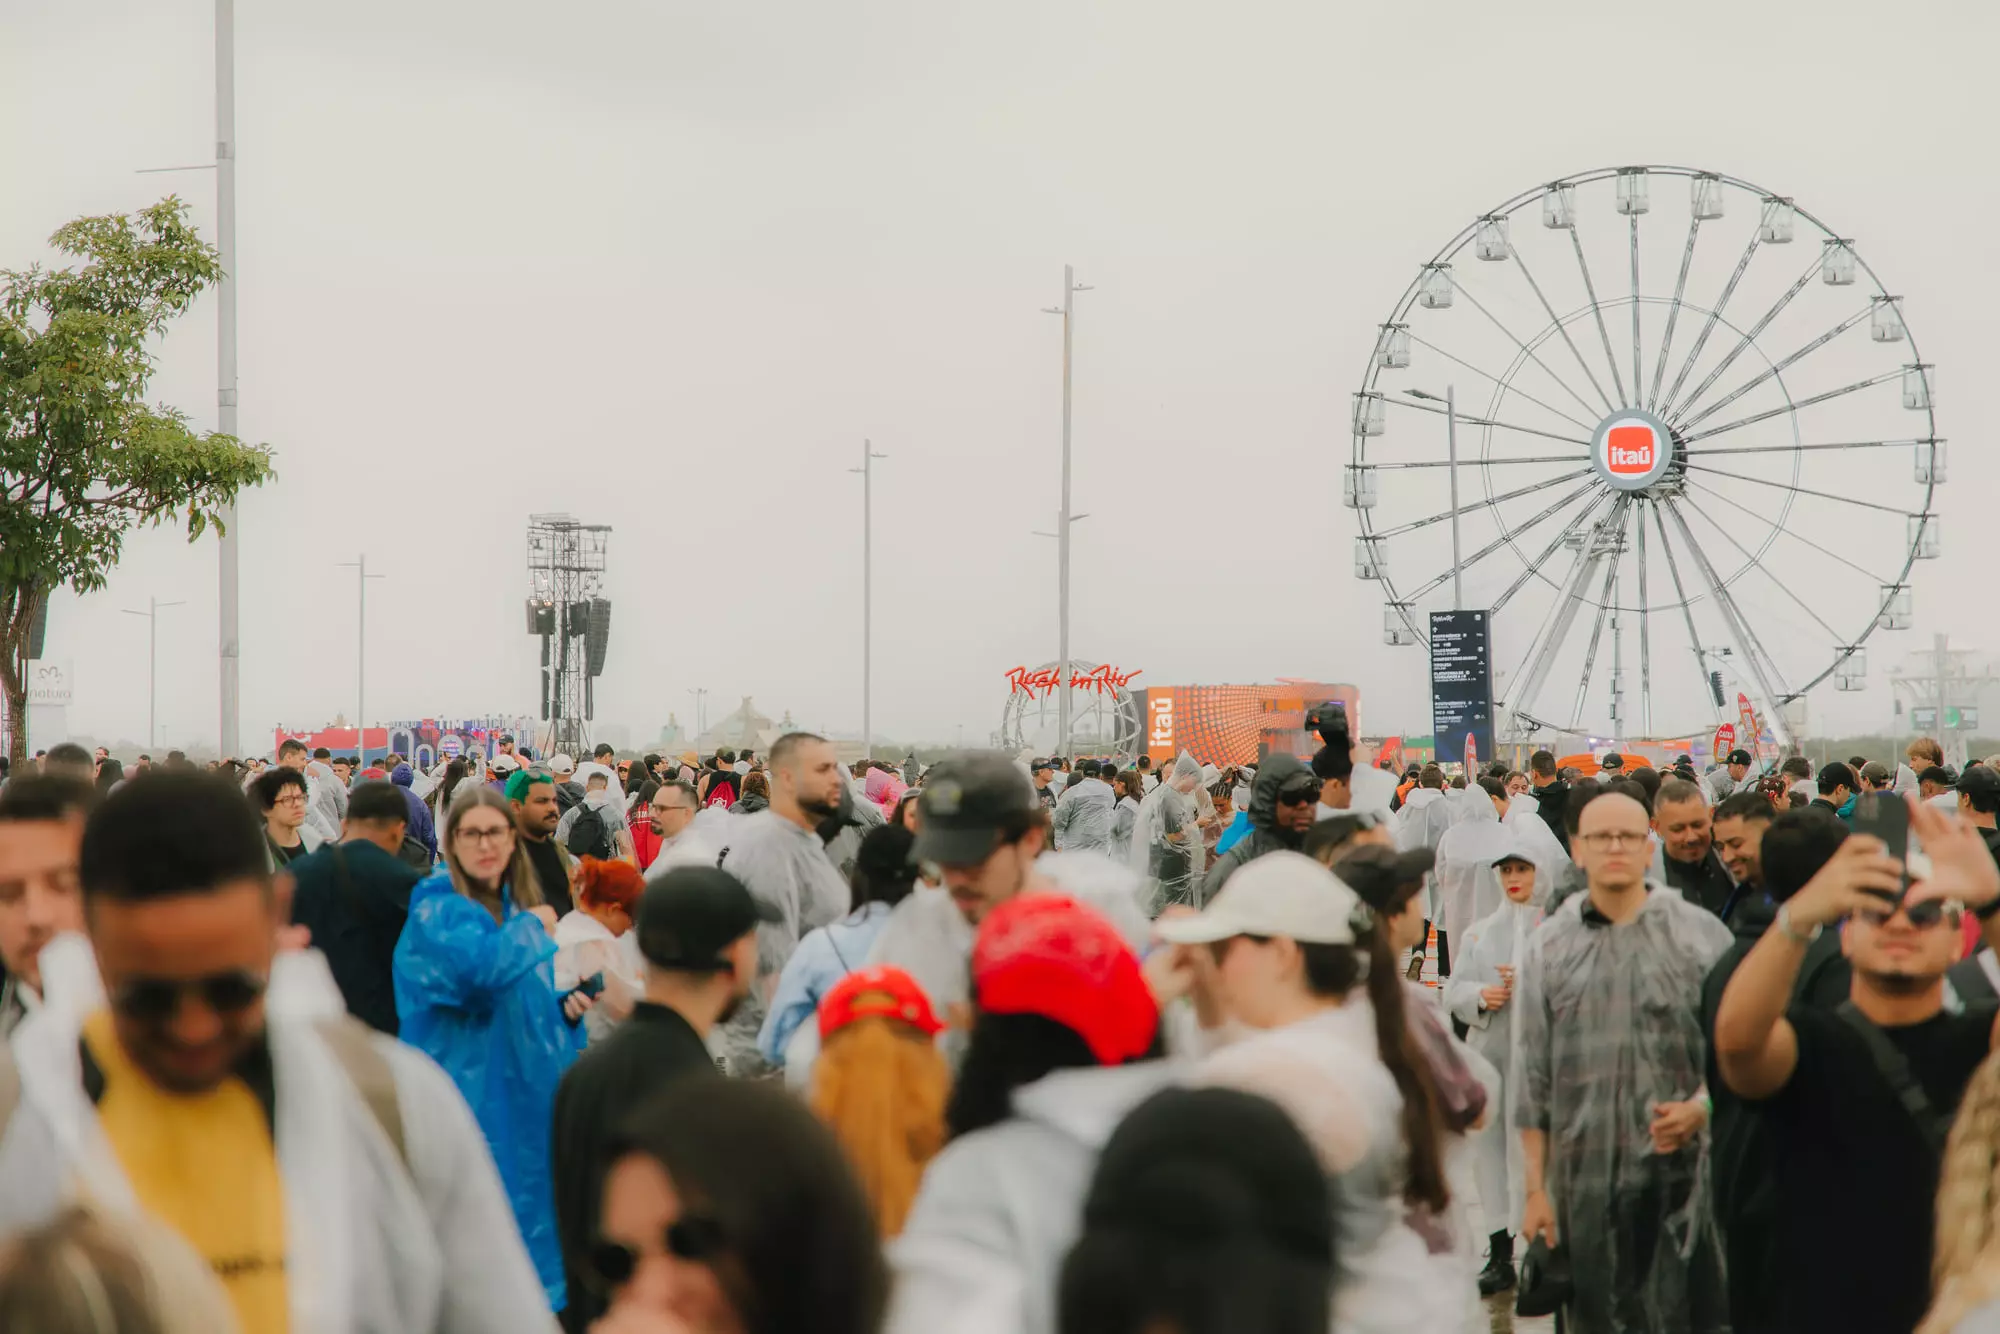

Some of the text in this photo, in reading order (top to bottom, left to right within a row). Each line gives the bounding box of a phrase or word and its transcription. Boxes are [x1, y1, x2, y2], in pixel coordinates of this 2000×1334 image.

[1611, 446, 1650, 465] itaú
[29, 688, 72, 700] natura
[1005, 664, 1144, 700] Rock in Rio
[1149, 697, 1173, 747] itaú
